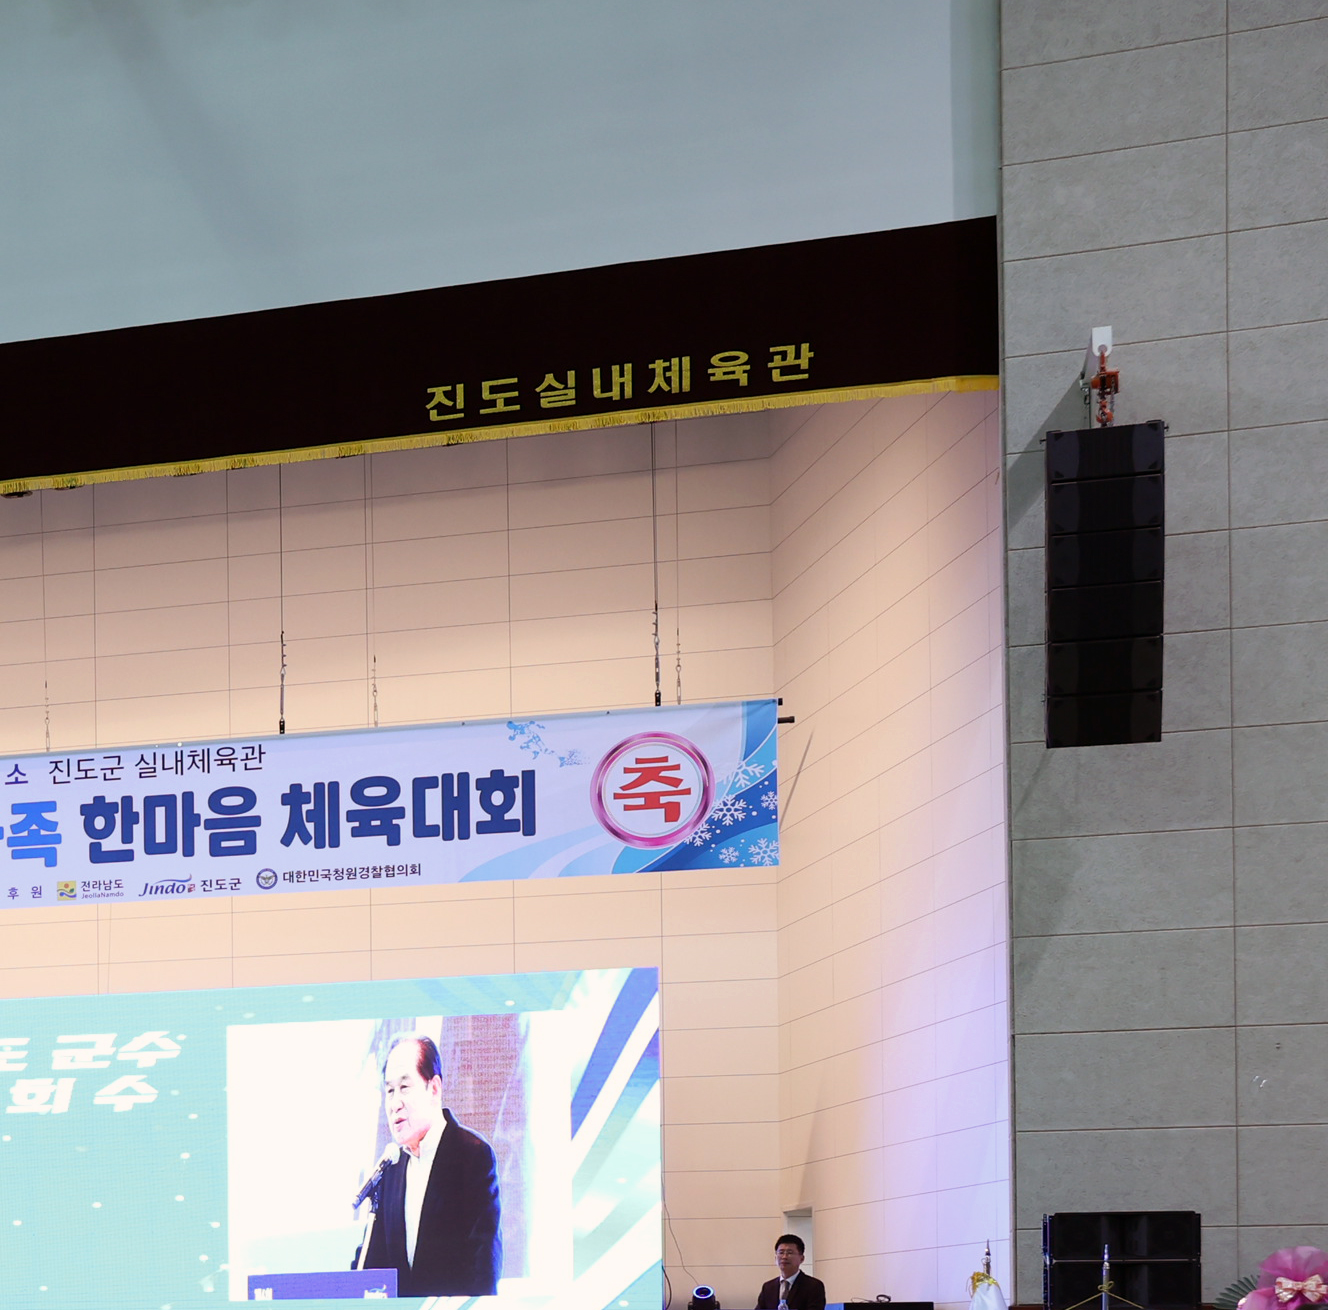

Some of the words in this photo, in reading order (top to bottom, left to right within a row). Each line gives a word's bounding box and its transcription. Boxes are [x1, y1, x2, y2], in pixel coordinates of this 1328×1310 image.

[425, 342, 815, 422] 진도실내체육관
[48, 755, 125, 785] 진도군
[134, 744, 266, 779] 실내체육관
[612, 754, 692, 824] 축
[80, 786, 260, 860] 한마음
[279, 767, 537, 852] 체육대회
[80, 878, 124, 892] 전라남도
[199, 876, 242, 893] 진도군
[281, 863, 422, 884] 대한민국청원경찰협의회
[50, 1030, 182, 1070] 군수
